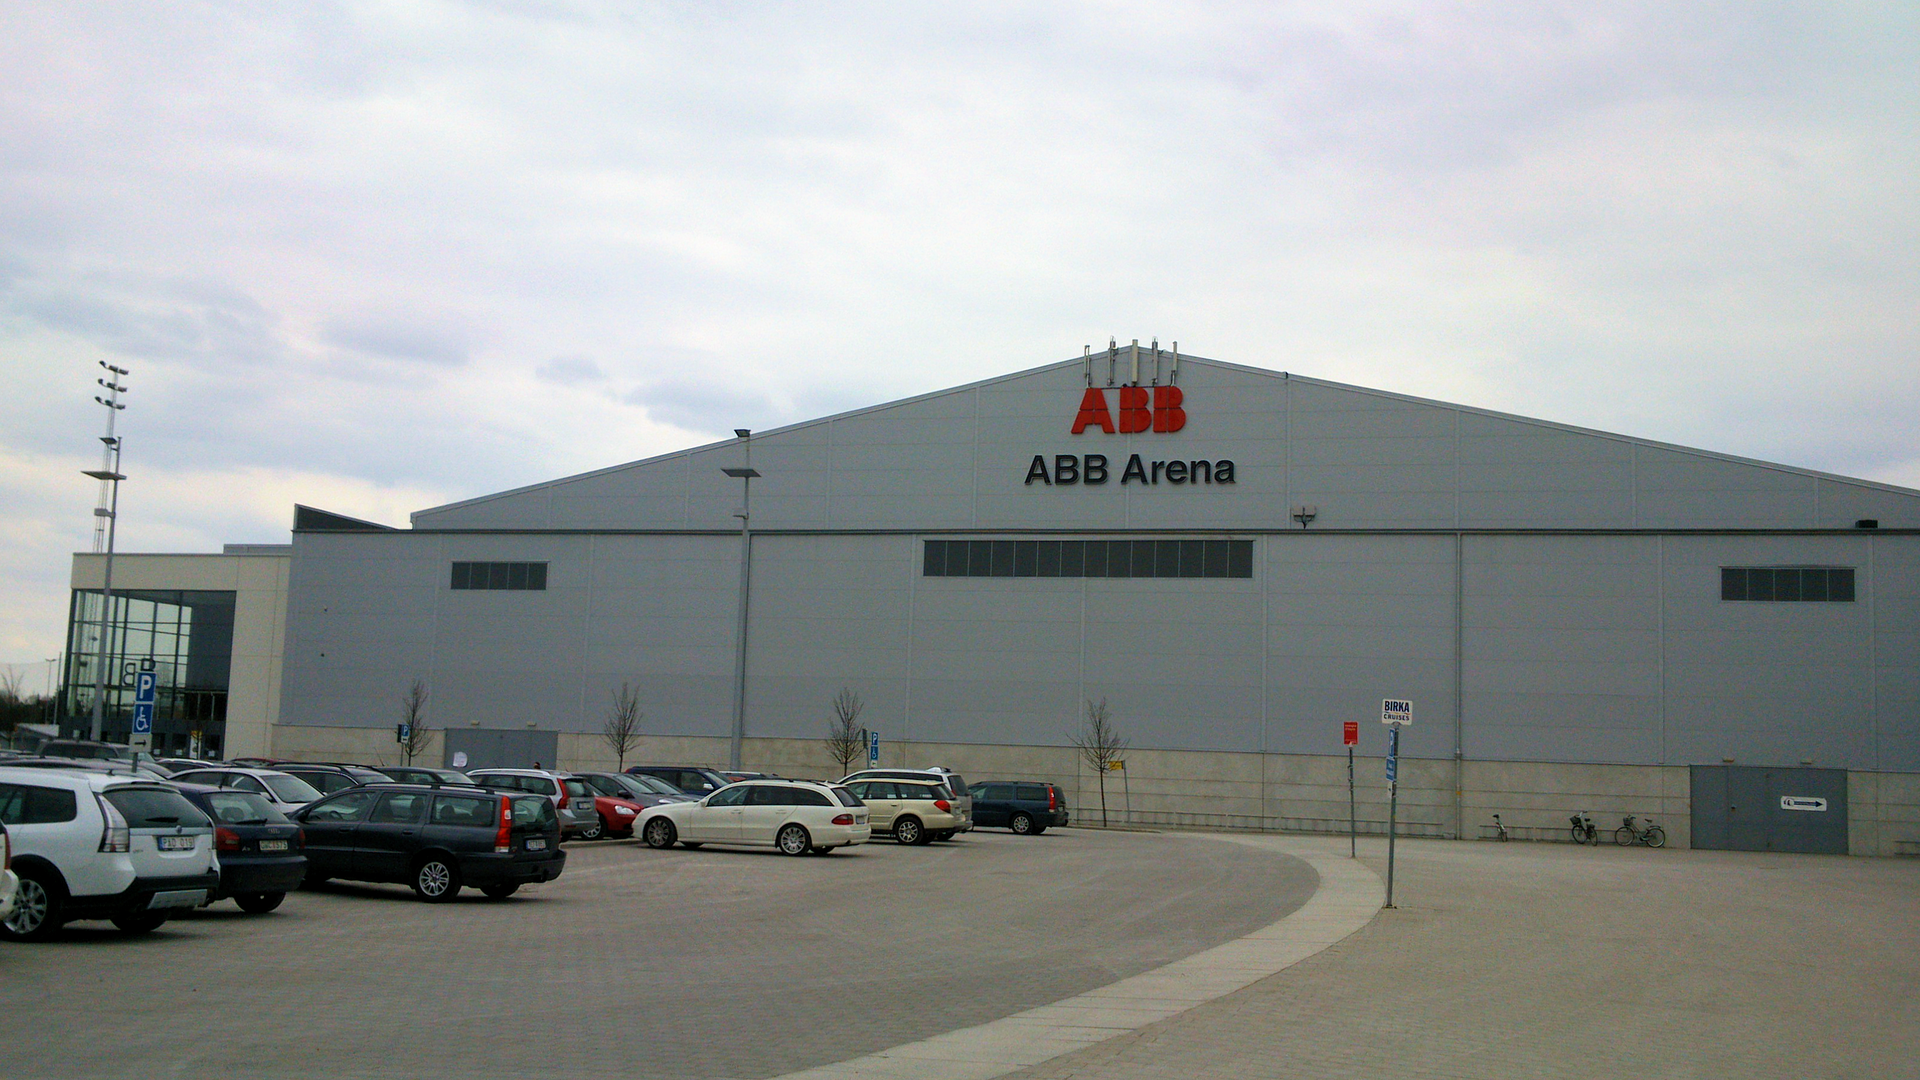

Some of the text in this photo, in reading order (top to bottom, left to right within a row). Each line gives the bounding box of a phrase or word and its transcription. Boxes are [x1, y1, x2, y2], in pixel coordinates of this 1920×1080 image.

[1071, 386, 1187, 434] ABB
[1024, 453, 1236, 485] ABB Arena
[139, 674, 152, 700] P
[1383, 713, 1410, 721] CRUISES
[1384, 700, 1410, 713] BIRKA
